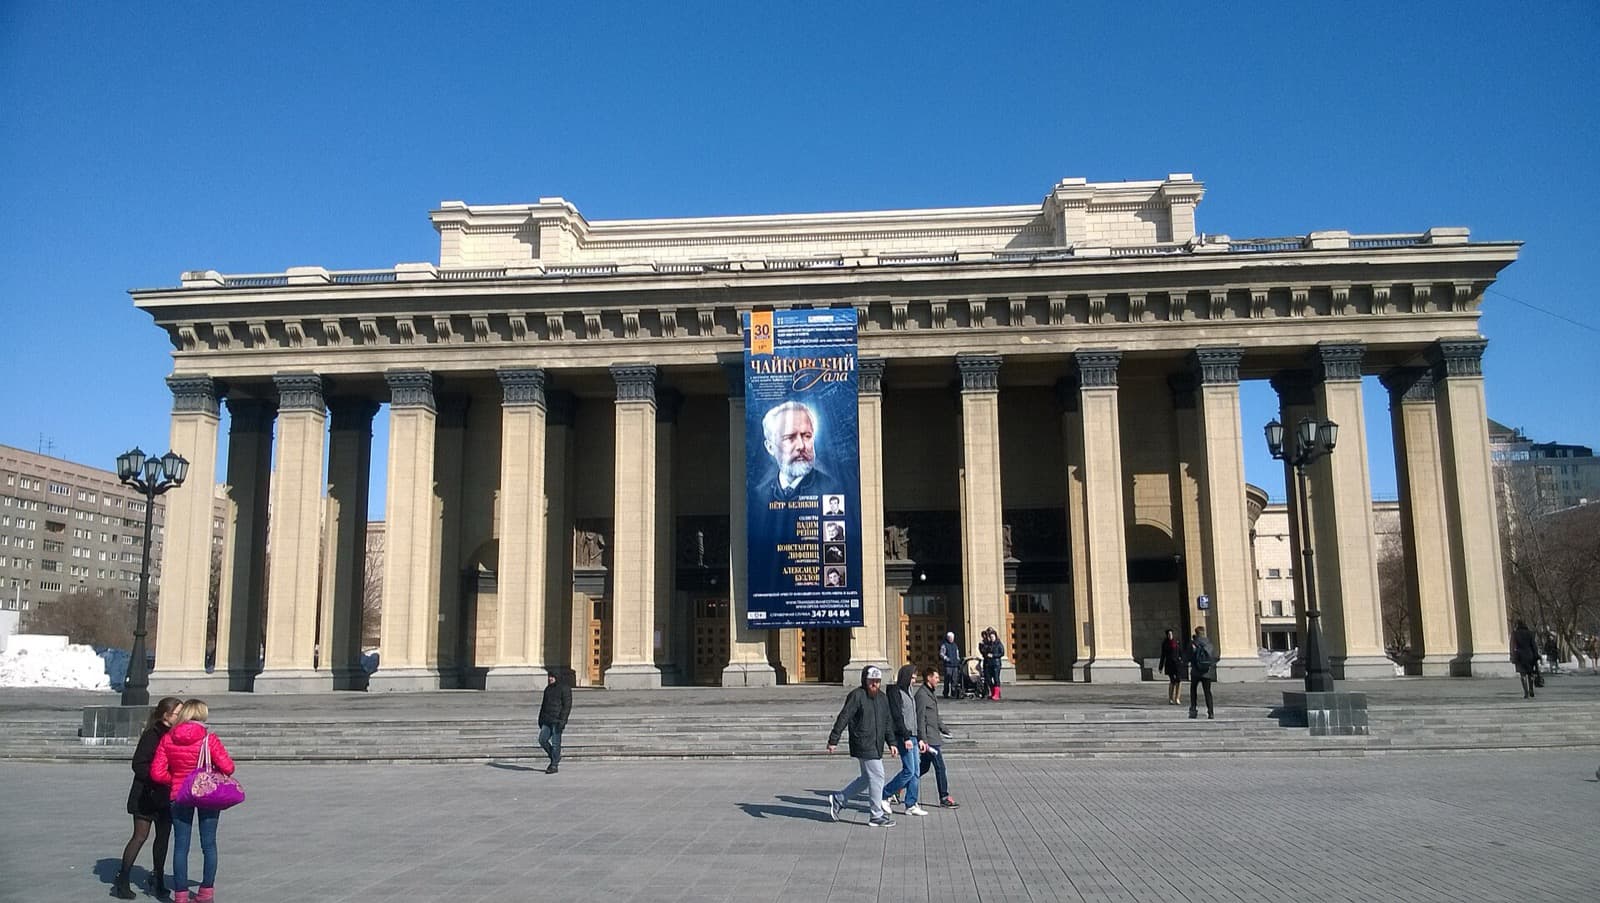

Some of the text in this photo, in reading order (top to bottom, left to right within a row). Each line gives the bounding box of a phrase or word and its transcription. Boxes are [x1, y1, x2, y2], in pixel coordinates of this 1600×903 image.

[754, 324, 770, 336] 30
[751, 354, 854, 374] ЧАЙКОВСКИЙ
[792, 367, 848, 392] Гала
[811, 610, 826, 618] 347
